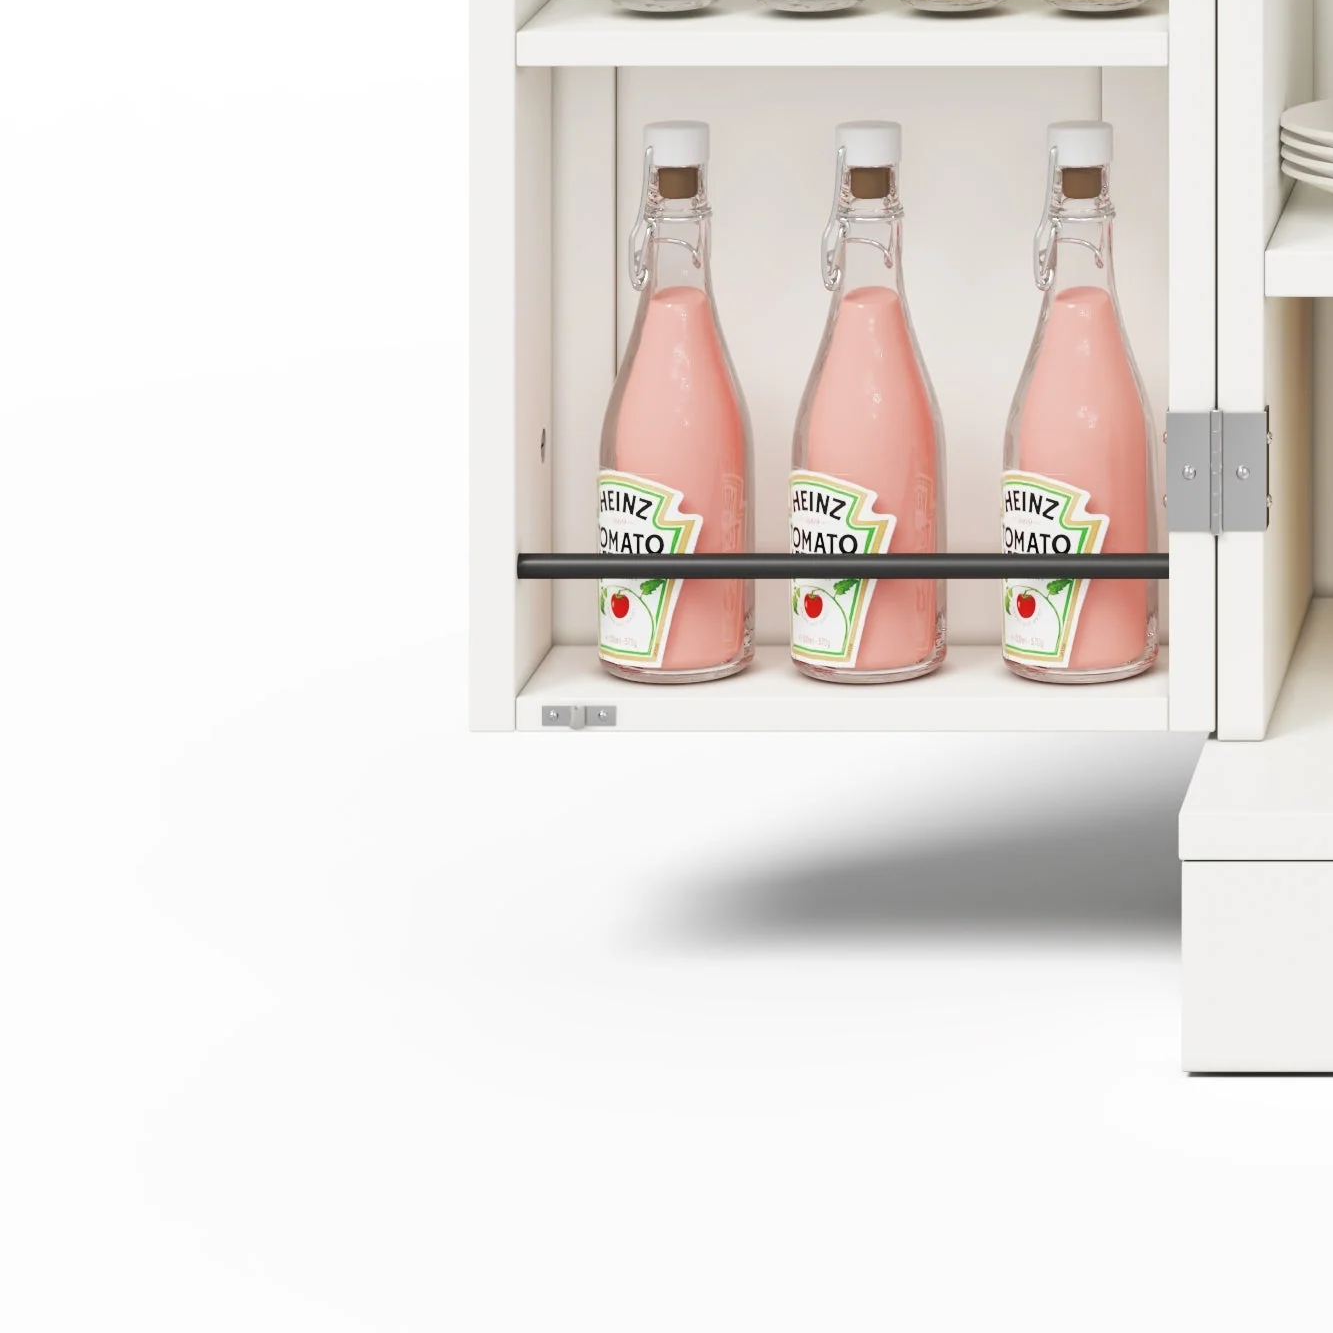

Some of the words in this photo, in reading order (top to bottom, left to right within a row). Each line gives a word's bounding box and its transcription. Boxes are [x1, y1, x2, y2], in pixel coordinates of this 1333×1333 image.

[600, 490, 653, 521] HEINZ
[793, 490, 846, 521] HEINZ
[1005, 490, 1060, 521] HEINZ
